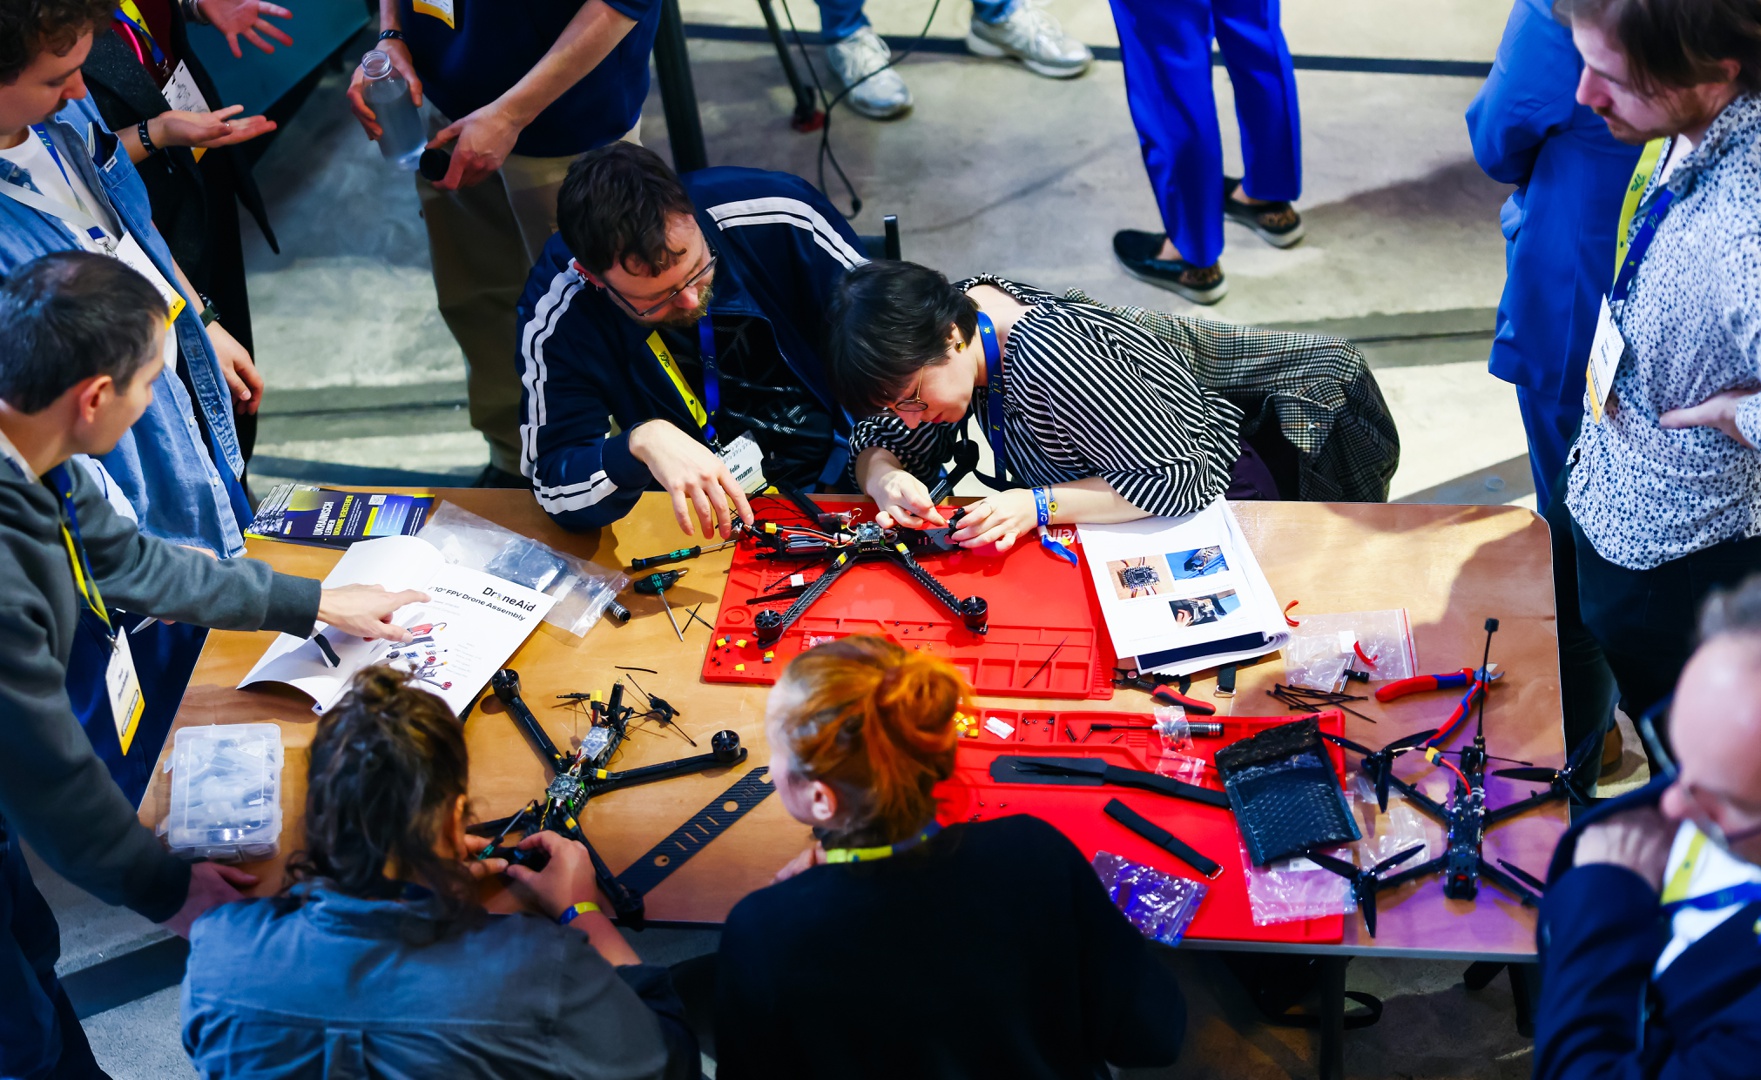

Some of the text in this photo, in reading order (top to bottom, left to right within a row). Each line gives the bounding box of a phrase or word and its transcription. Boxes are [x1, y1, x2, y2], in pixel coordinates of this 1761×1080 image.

[446, 589, 463, 597] FPV
[462, 593, 486, 606] Drone
[485, 602, 526, 622] Assembly
